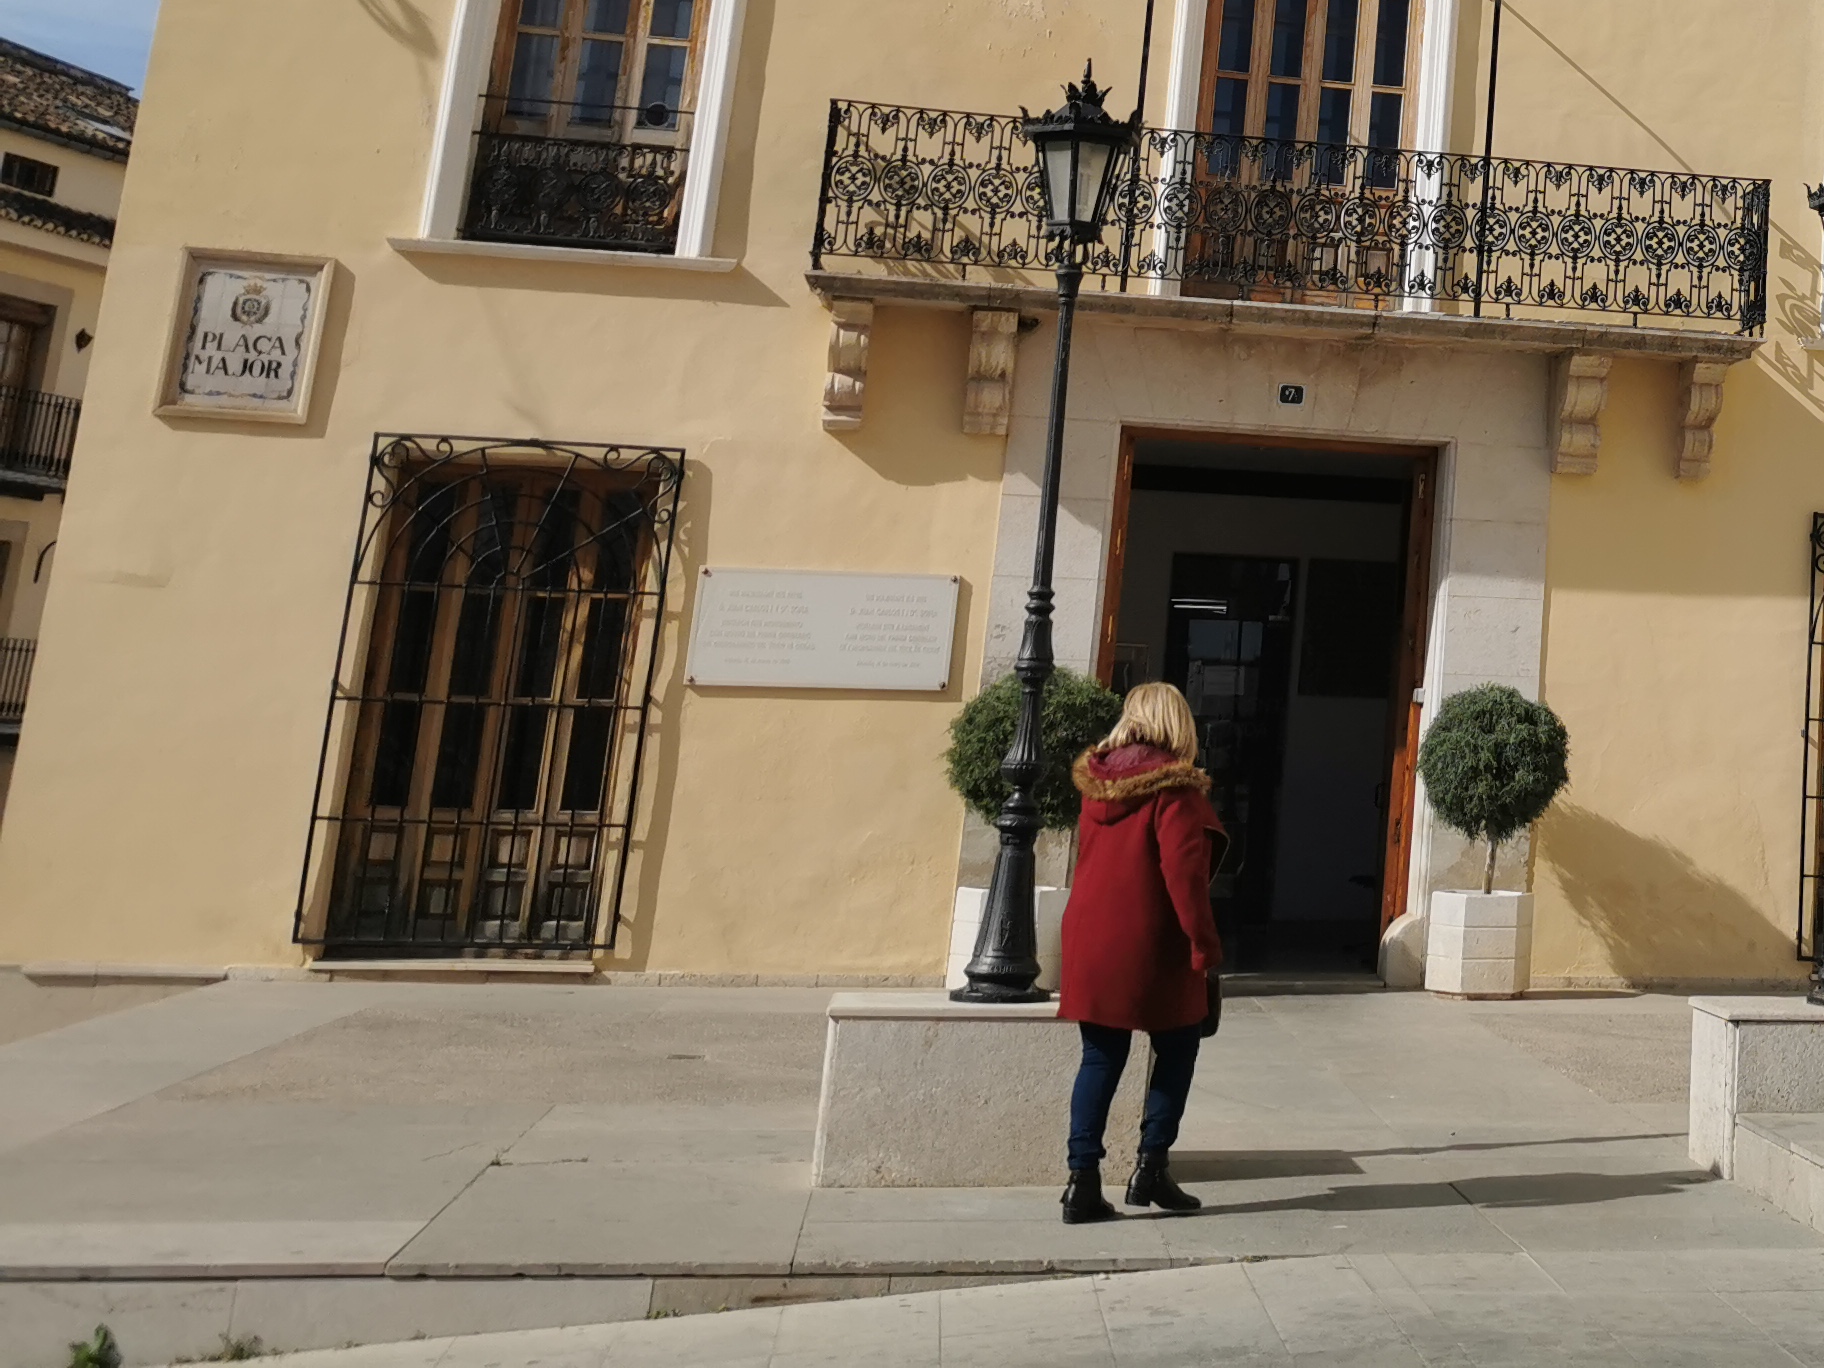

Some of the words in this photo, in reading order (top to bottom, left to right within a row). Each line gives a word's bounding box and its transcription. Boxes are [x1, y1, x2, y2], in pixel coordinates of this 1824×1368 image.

[200, 331, 287, 356] PLAÇA
[191, 354, 283, 379] MAJOR
[1285, 387, 1296, 401] 7
